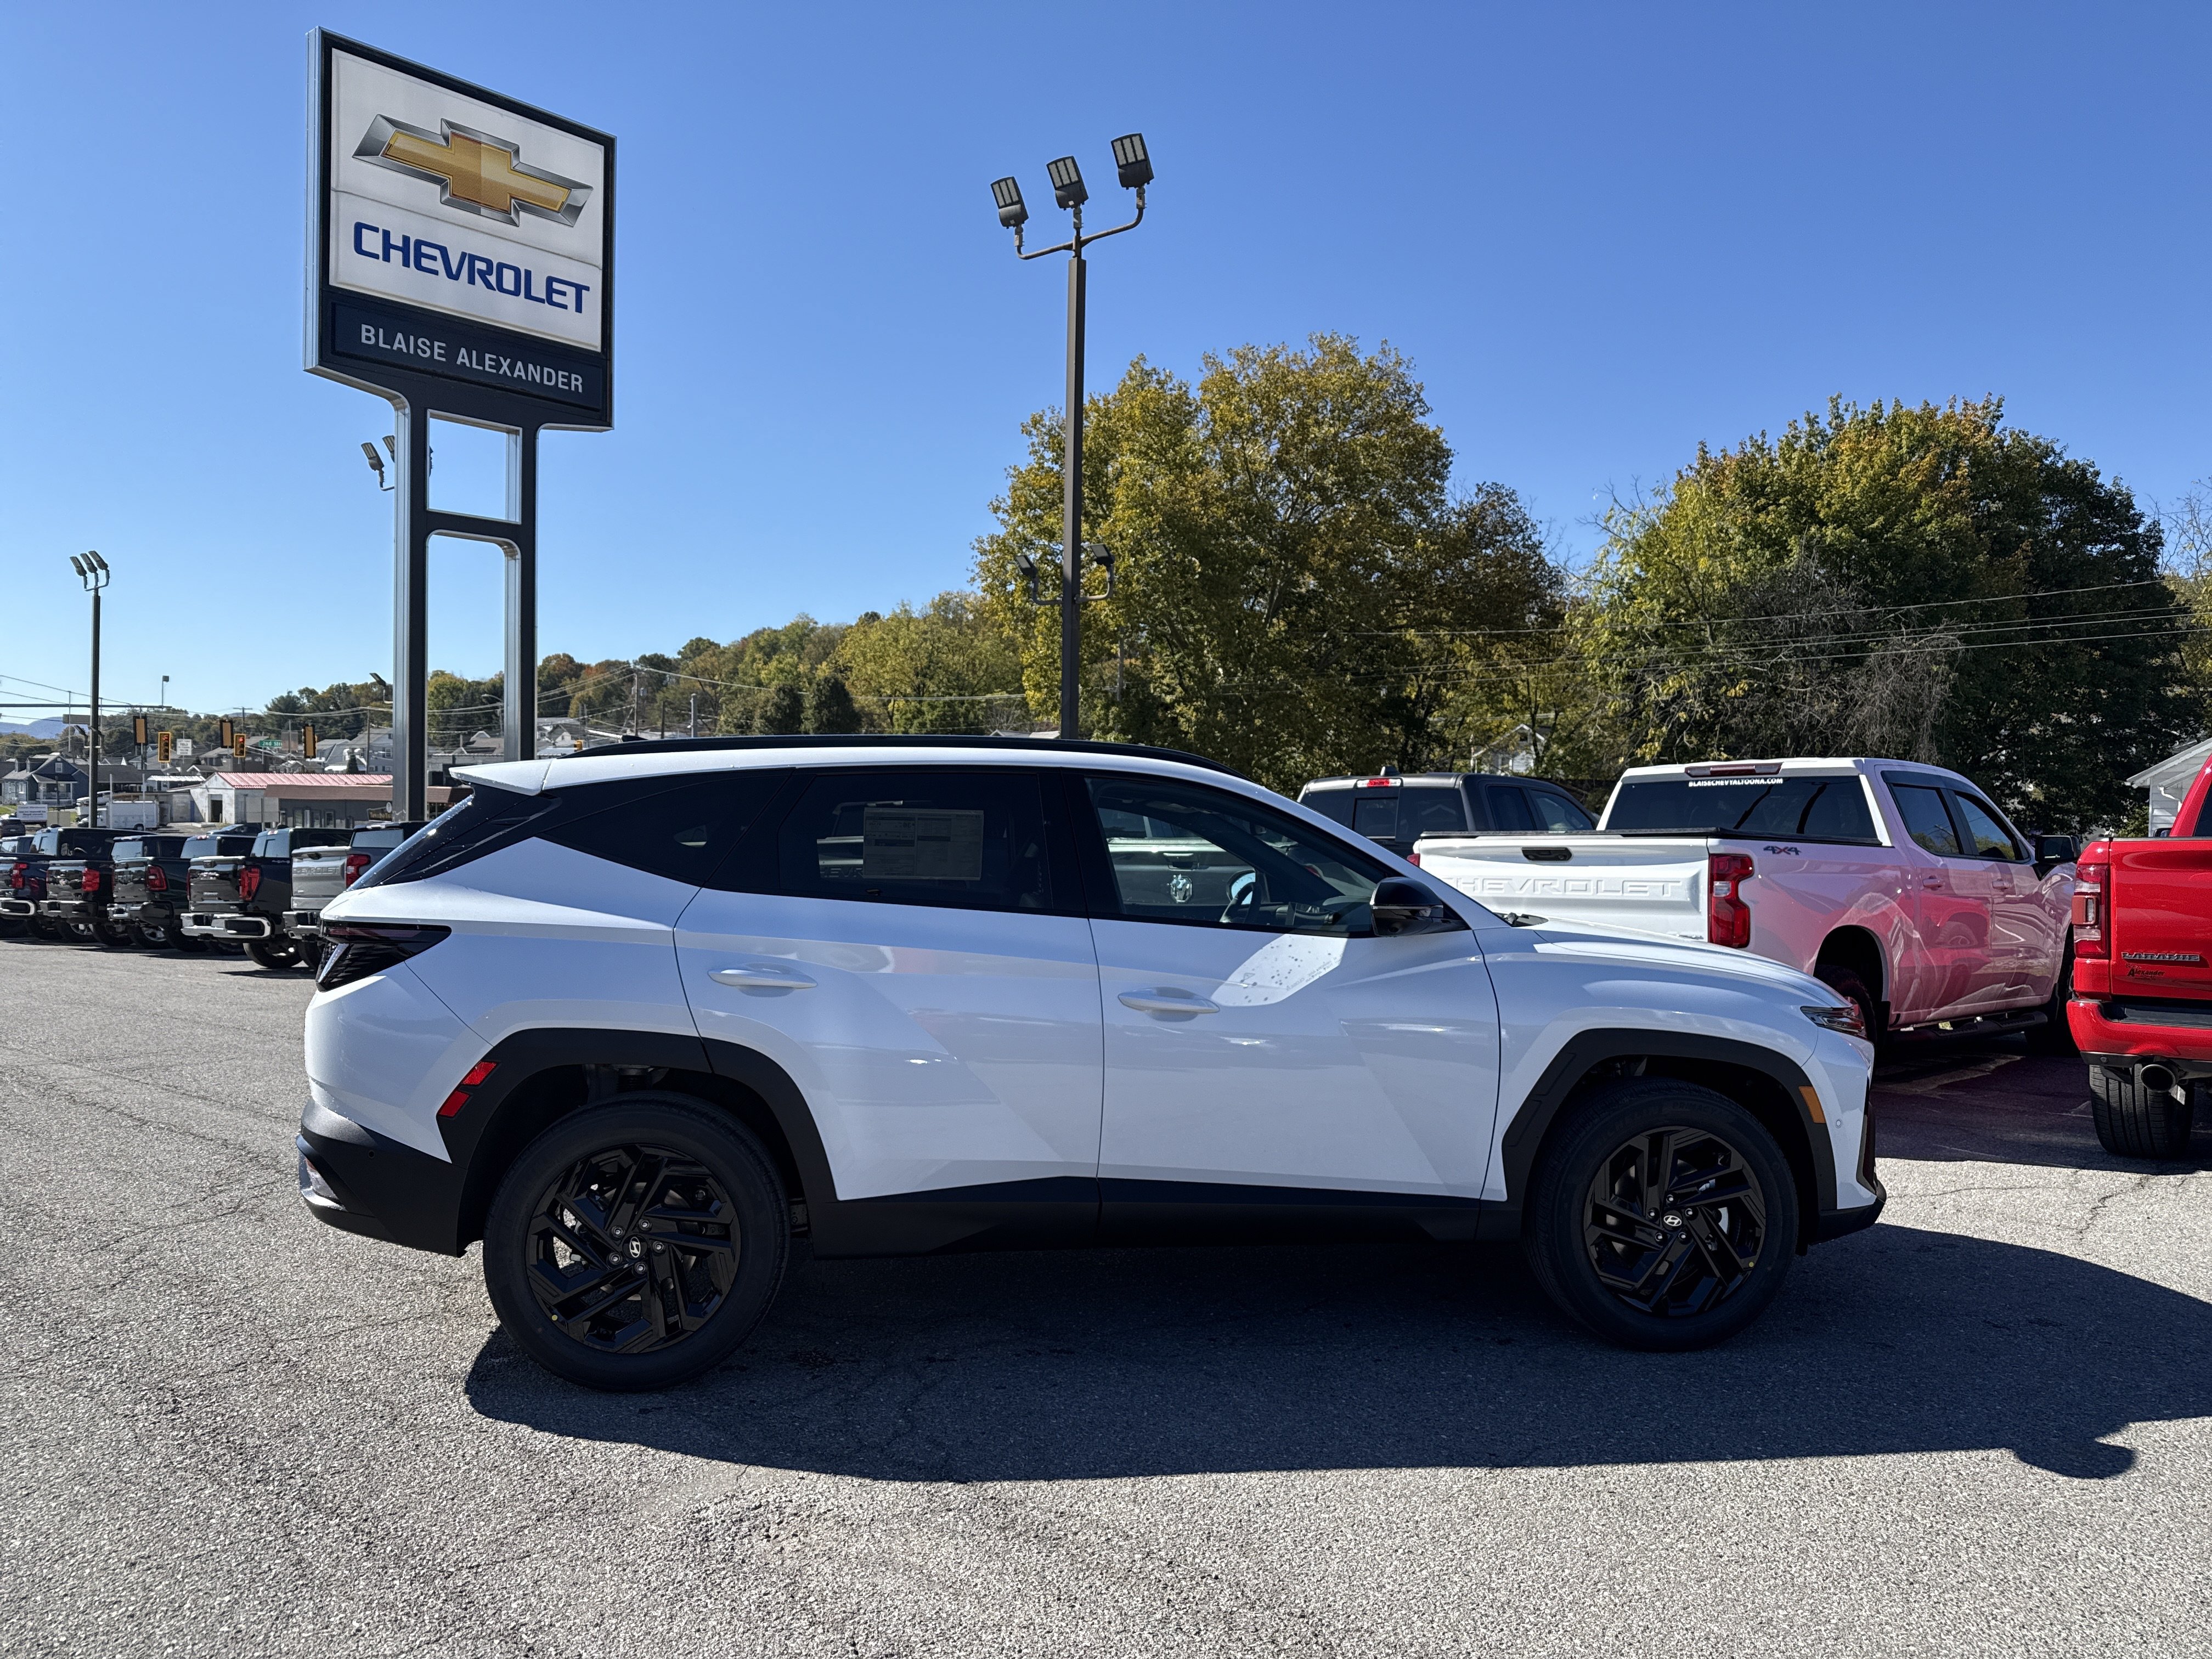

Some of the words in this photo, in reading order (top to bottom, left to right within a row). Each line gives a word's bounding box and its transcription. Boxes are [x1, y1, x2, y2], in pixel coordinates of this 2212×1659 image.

[354, 222, 590, 313] CHEVROLET
[361, 324, 446, 361] BLAISE
[456, 347, 583, 393] ALEXANDER
[1689, 778, 1783, 787] BLAISECHEVYALTOONA.COM
[2121, 952, 2200, 962] LARAMIE
[2127, 968, 2165, 977] Alexander
